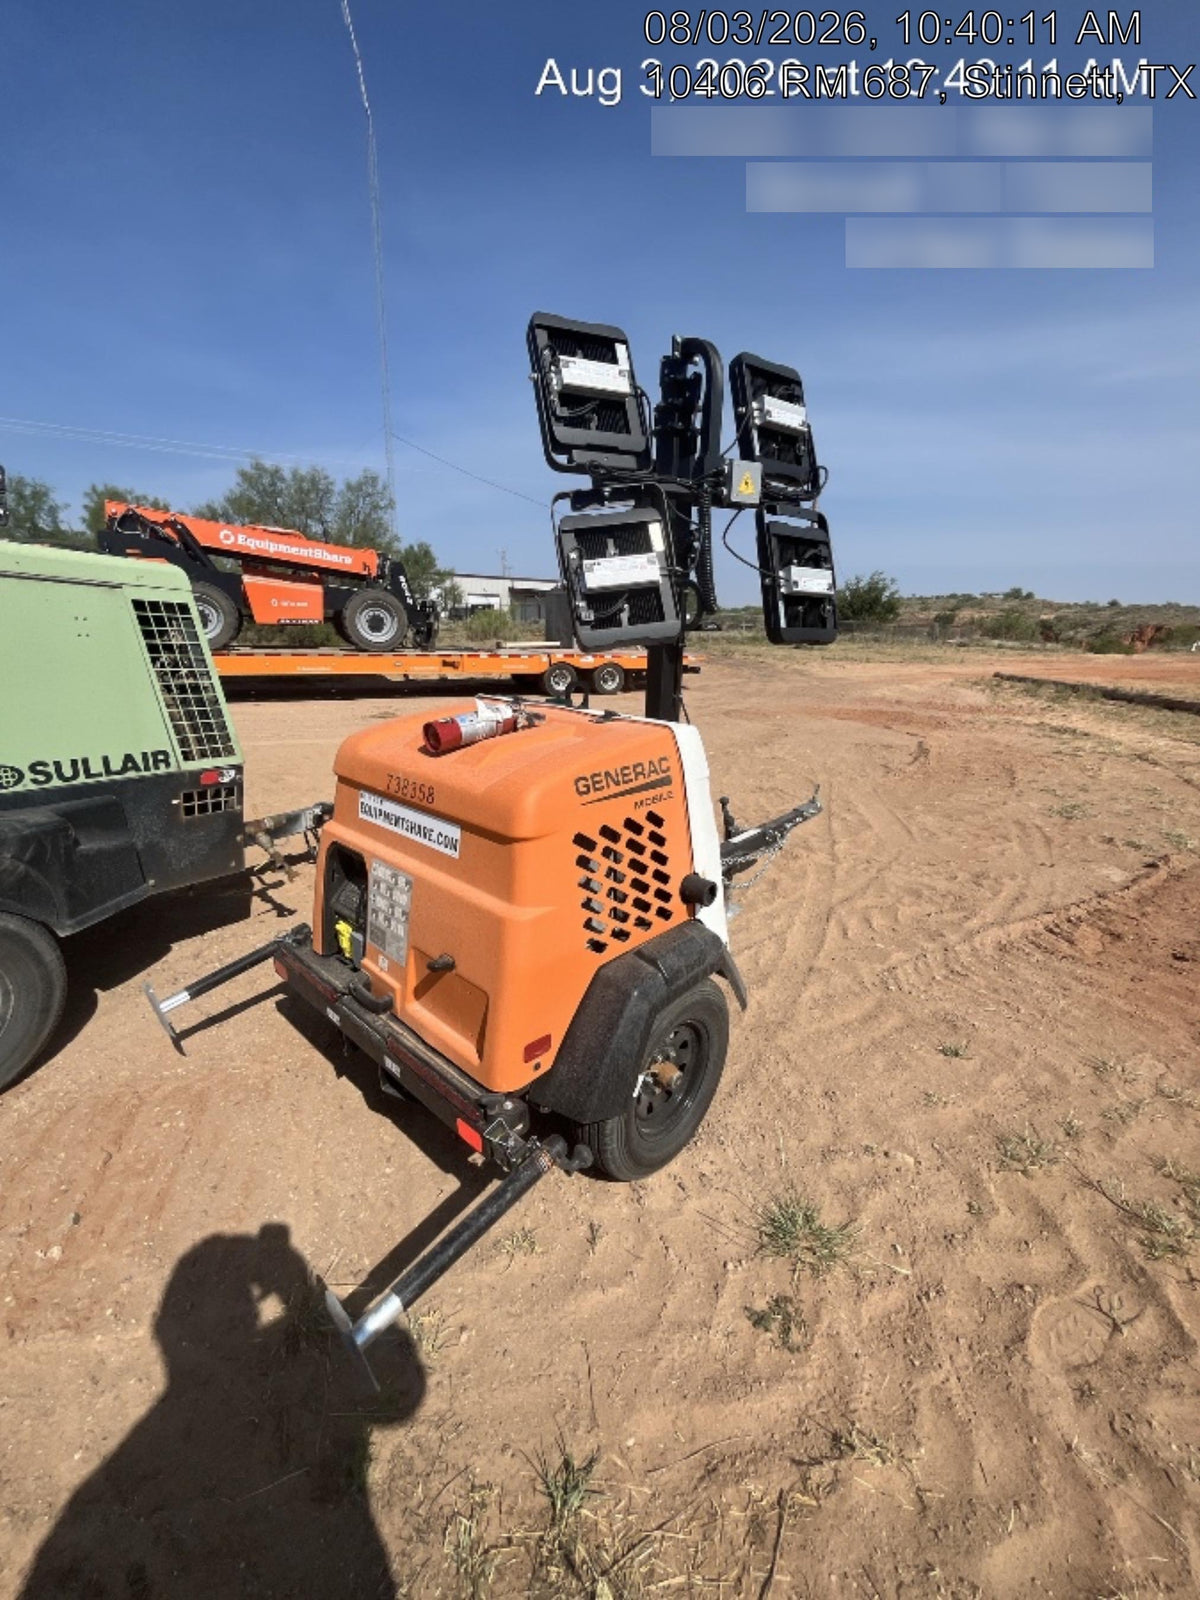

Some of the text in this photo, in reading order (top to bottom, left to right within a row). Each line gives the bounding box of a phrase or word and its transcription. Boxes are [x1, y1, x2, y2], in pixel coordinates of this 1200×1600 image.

[237, 534, 353, 564] EquipmentShare
[27, 749, 172, 786] SULLAIR
[574, 756, 671, 796] GENERAC
[360, 801, 459, 853] EQUIPMENTSHARE.COM
